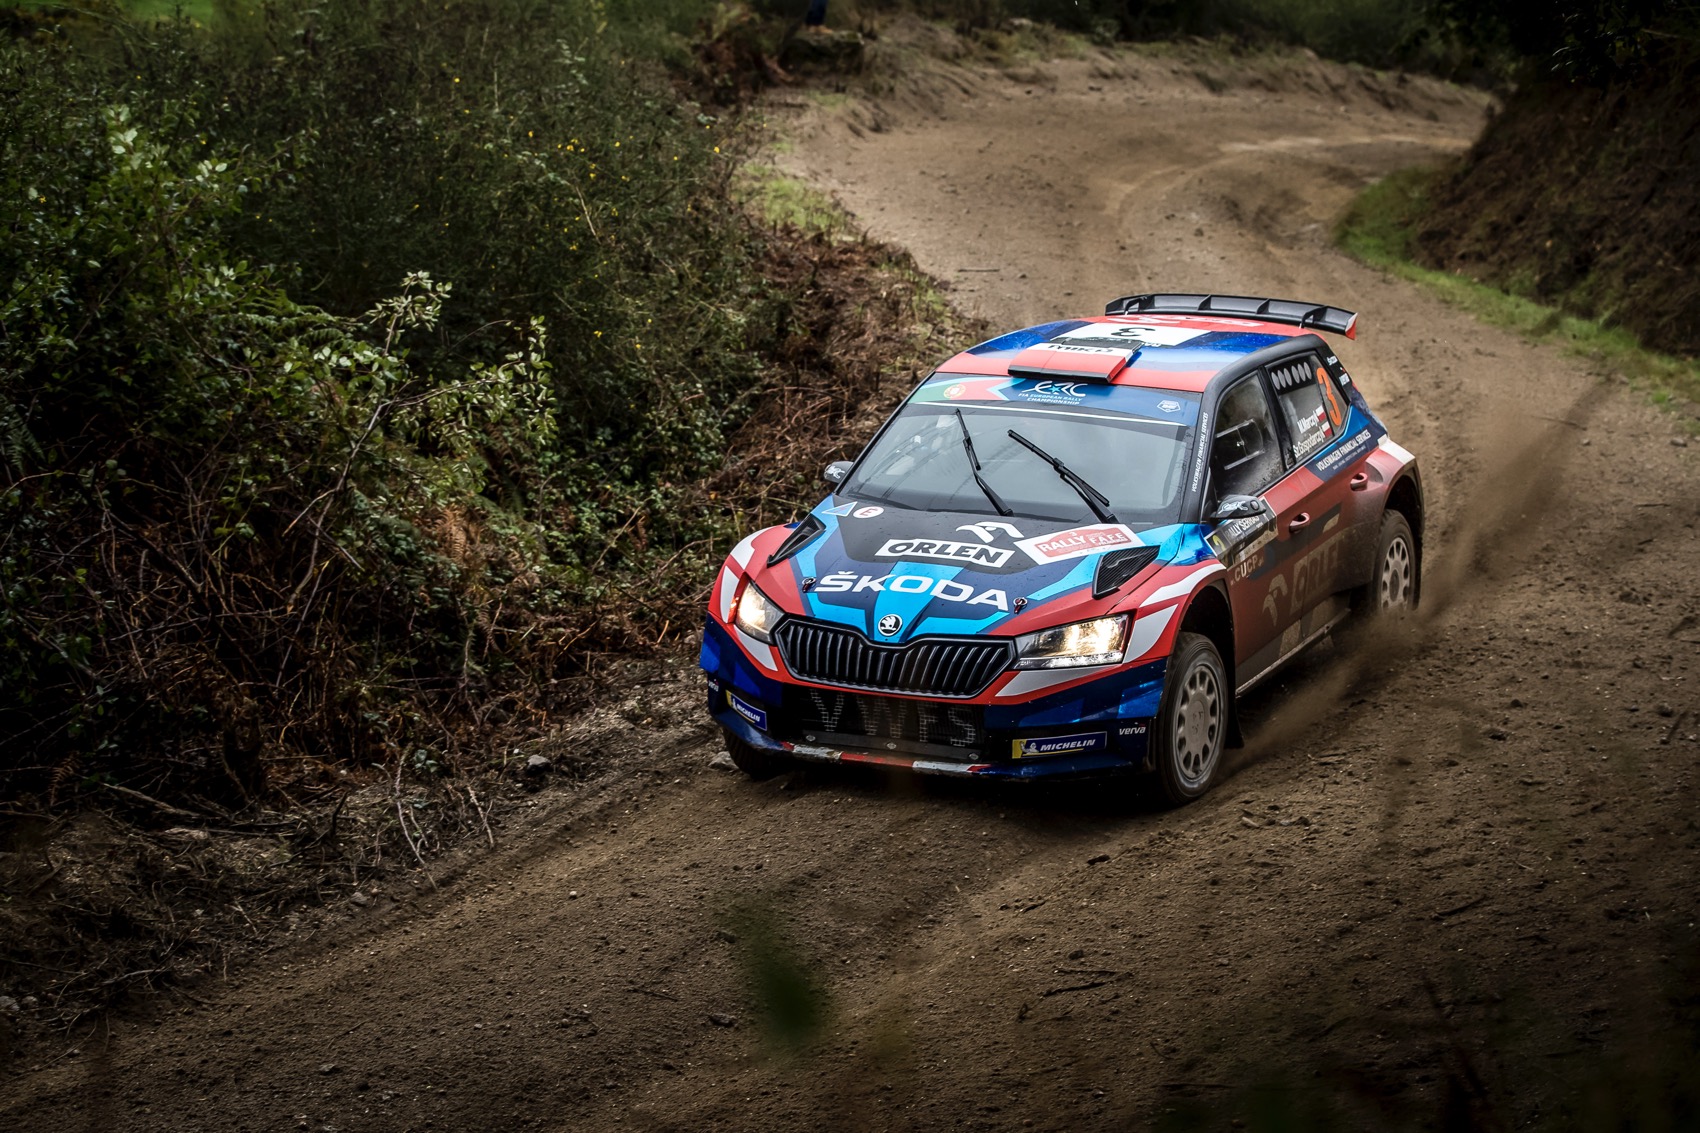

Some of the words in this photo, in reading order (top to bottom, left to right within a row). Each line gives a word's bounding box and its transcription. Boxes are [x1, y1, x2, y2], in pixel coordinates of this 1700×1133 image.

[1027, 397, 1080, 405] CHAMPIONSHIP
[1029, 393, 1063, 402] EUROPEAN
[1316, 367, 1342, 426] 3
[859, 506, 879, 516] E
[888, 541, 1003, 564] ORLEN
[1039, 535, 1087, 553] RALLY
[1088, 532, 1123, 544] FAFE
[814, 570, 1009, 611] ŠKODA
[736, 703, 761, 722] MICHELIN
[810, 689, 977, 748] VWFS
[1040, 739, 1096, 752] MICHELIN
